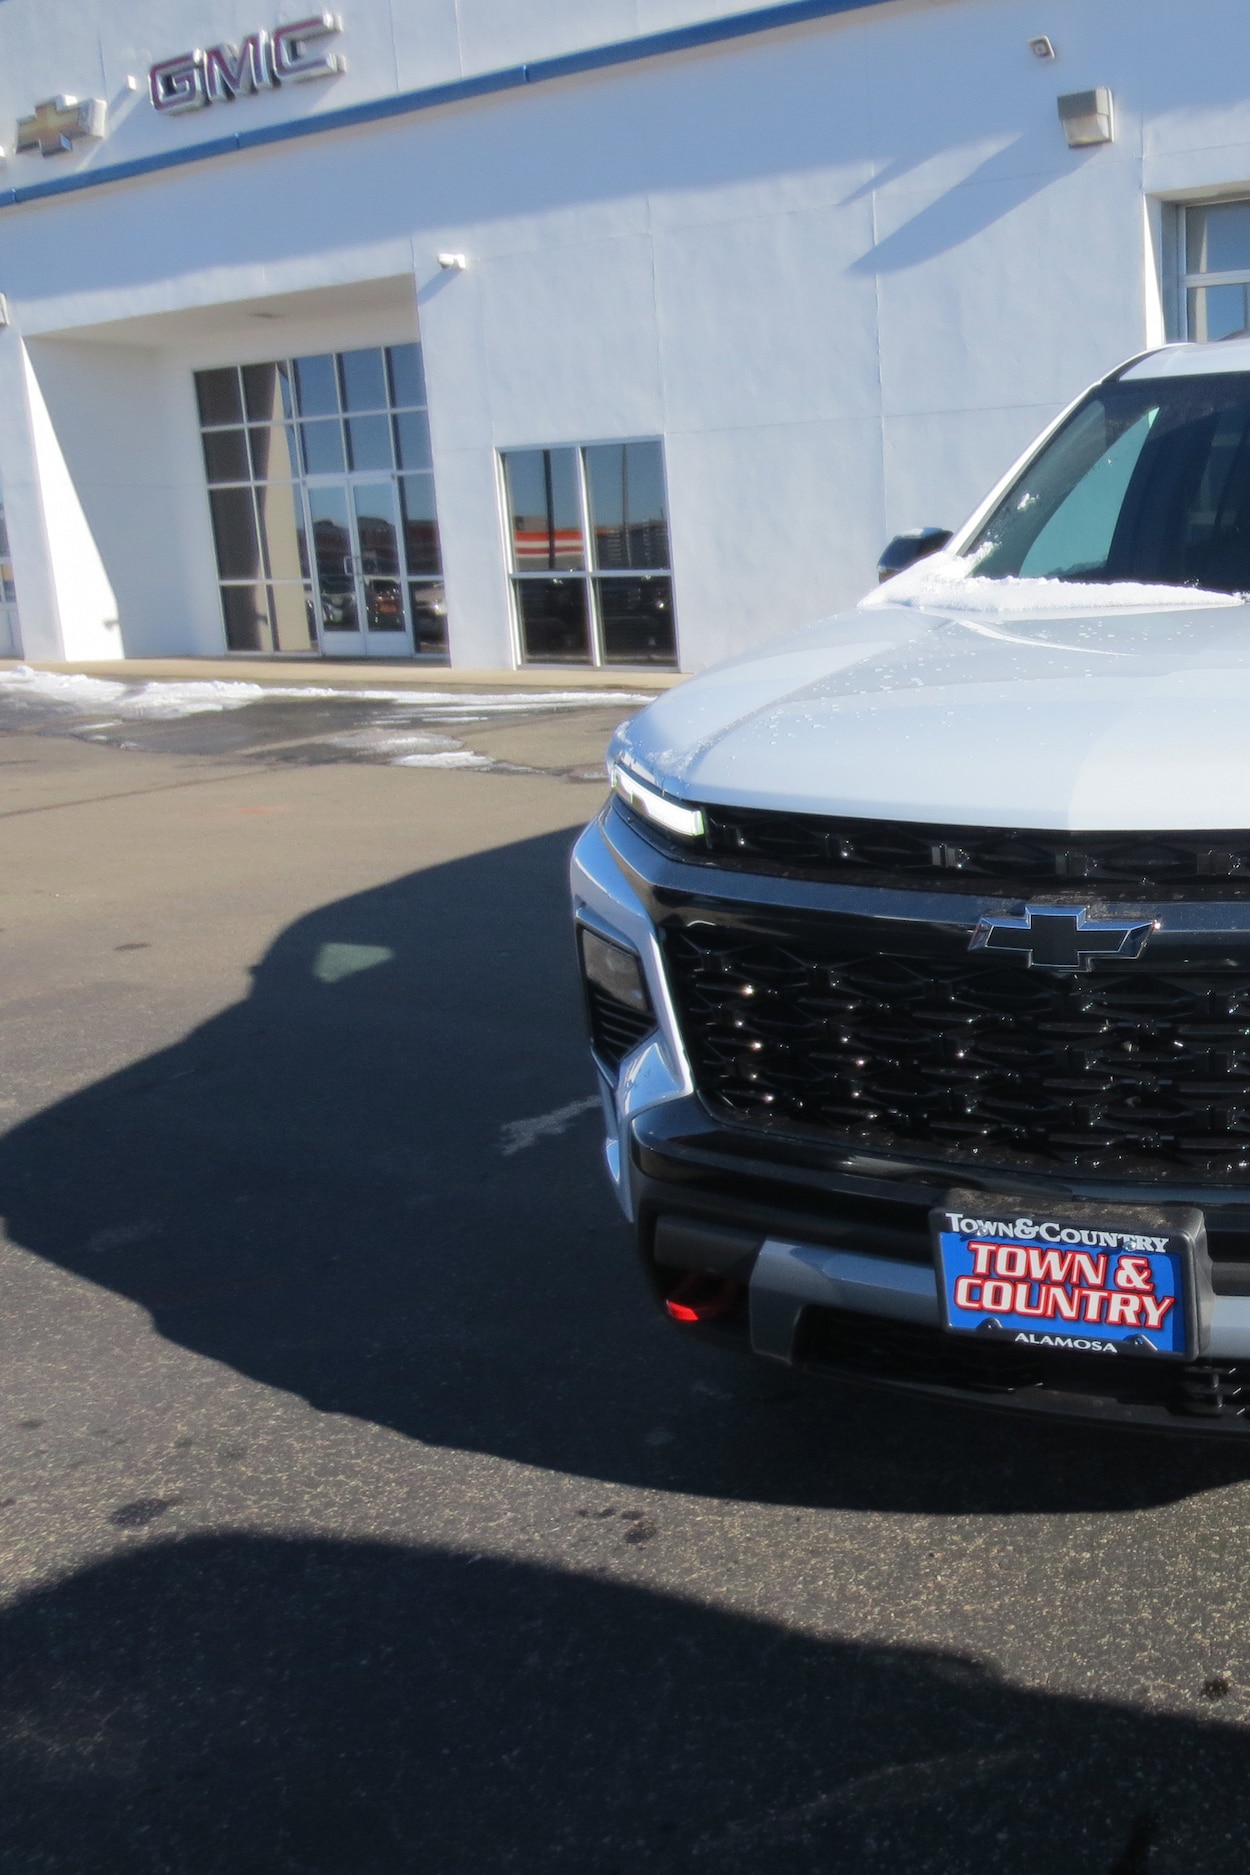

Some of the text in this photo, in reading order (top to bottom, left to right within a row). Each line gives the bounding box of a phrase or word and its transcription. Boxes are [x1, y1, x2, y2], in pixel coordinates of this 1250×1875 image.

[148, 11, 346, 116] GMC
[968, 1242, 1154, 1291] TOWN &
[955, 1276, 1174, 1328] COUNTRY
[1014, 1332, 1118, 1353] ALAMOSA
